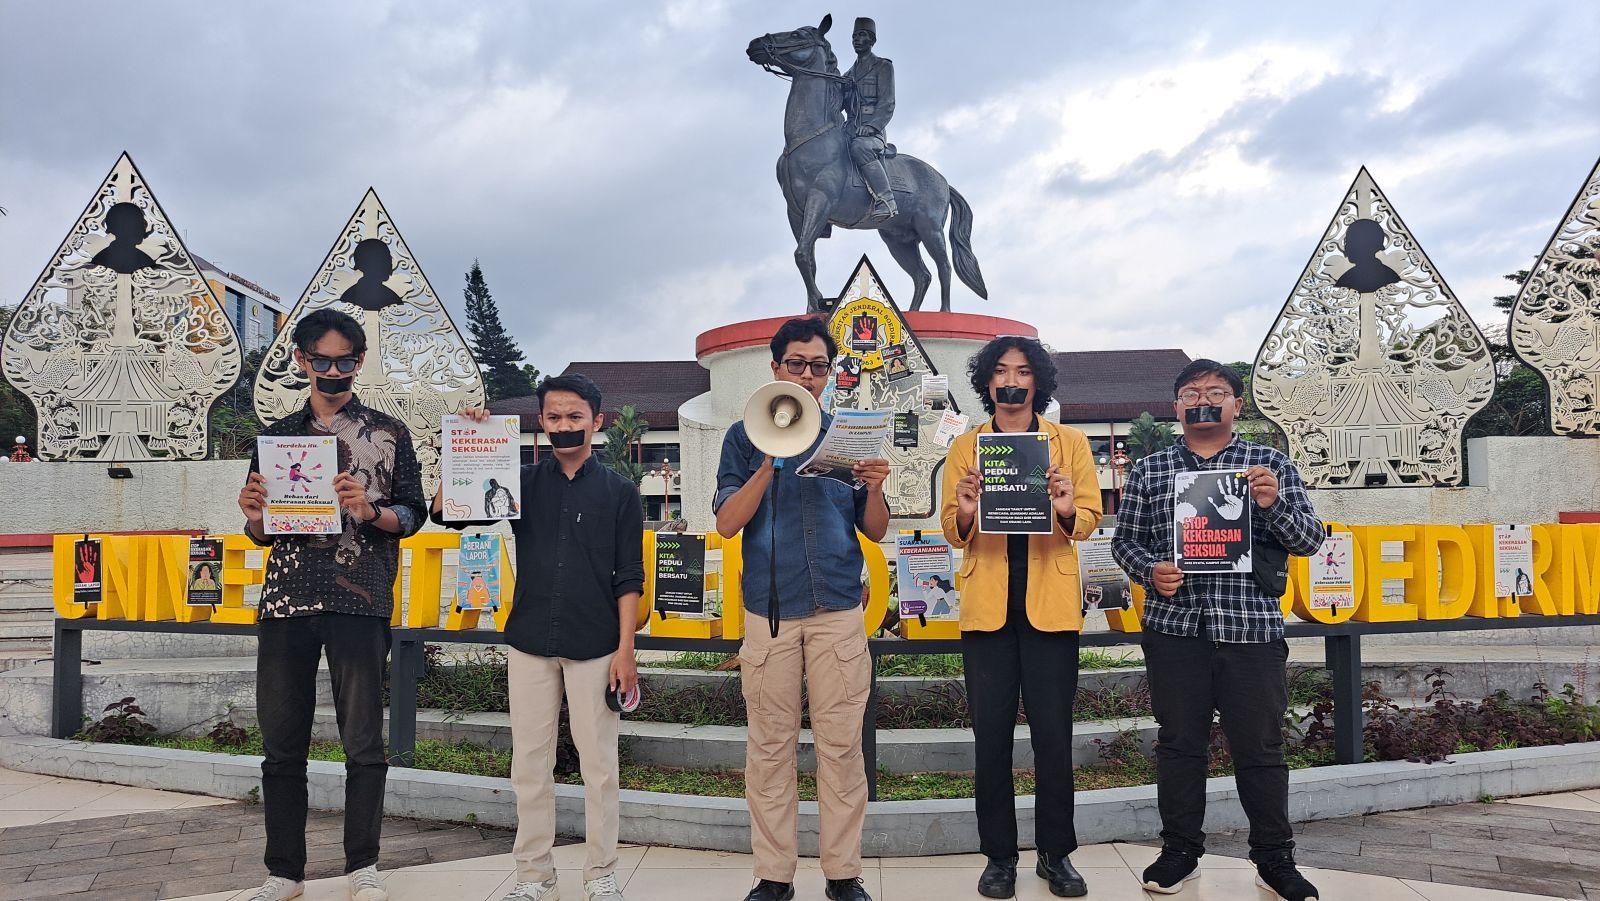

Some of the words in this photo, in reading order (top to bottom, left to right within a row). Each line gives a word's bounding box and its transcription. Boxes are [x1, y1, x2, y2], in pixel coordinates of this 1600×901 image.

[850, 304, 883, 315] JENDERAL
[984, 468, 1018, 476] PEDULI
[984, 476, 1006, 484] KITA
[985, 484, 1028, 492] BERSATU
[1183, 516, 1208, 530] STOP
[1183, 529, 1242, 542] KEKERASAN
[465, 551, 488, 560] LAPOR
[1183, 544, 1228, 557] SEKSUAL
